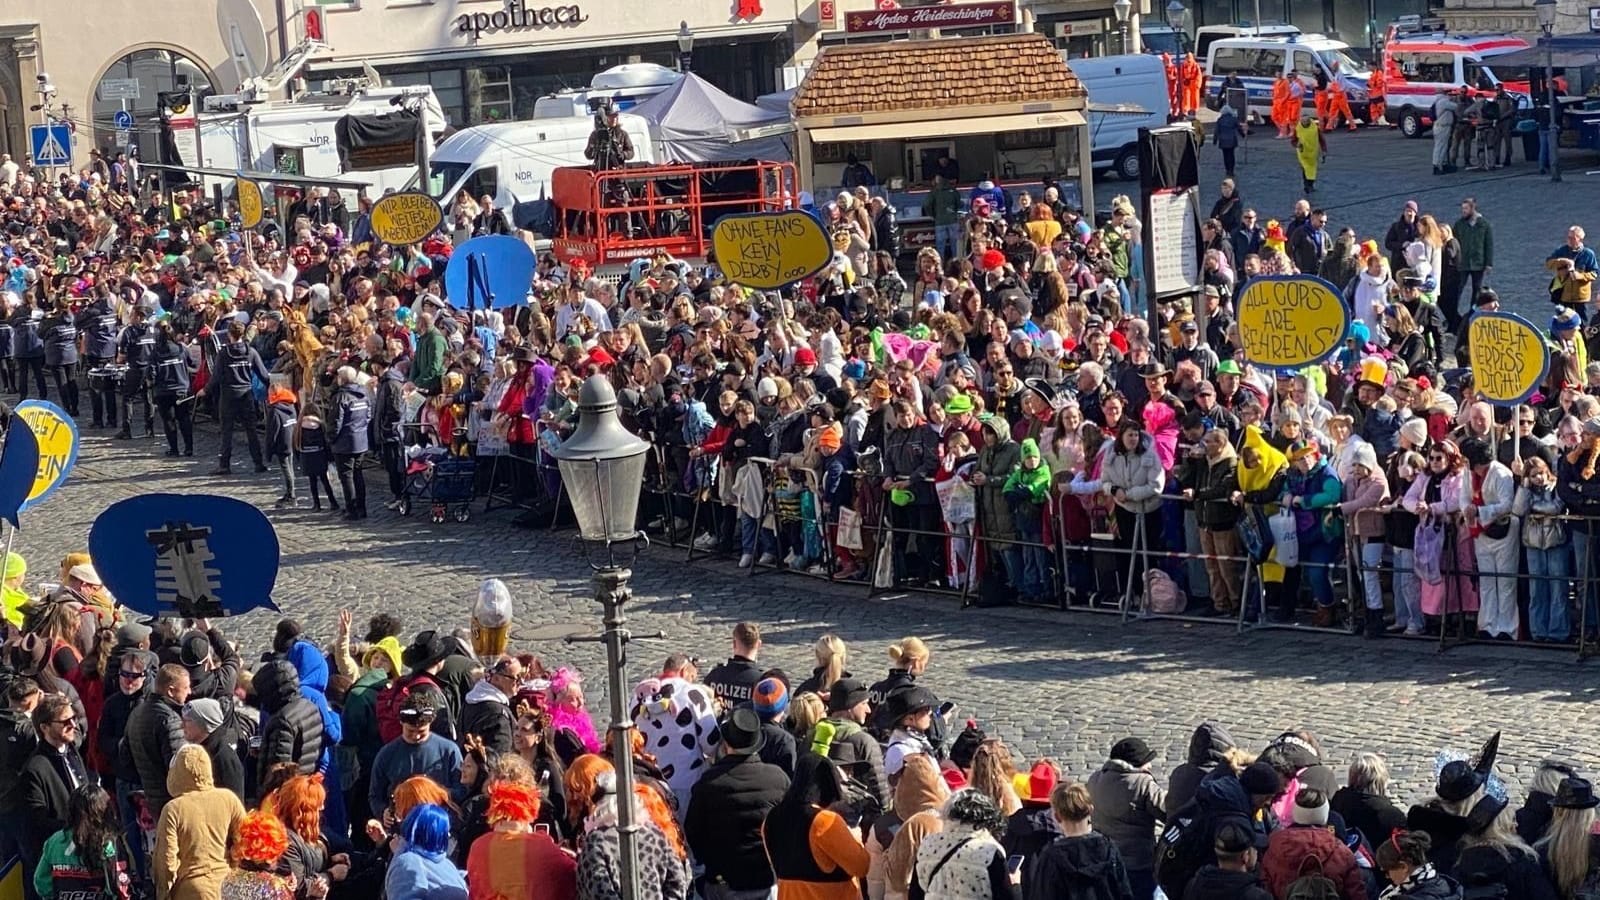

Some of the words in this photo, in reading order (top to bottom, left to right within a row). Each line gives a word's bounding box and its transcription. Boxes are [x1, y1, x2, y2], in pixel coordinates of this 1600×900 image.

[459, 0, 589, 40] apotheca
[912, 8, 994, 23] Heideschinken
[515, 168, 532, 182] NDR
[380, 198, 398, 215] WIR
[720, 220, 764, 242] OHNE
[765, 218, 805, 238] FANS
[740, 239, 781, 261] KEIN
[1246, 284, 1269, 311] ALL
[1273, 281, 1325, 310] COPS
[1264, 308, 1296, 332] ARE
[1242, 323, 1340, 360] BEHRENS!
[1474, 319, 1528, 351] DANIELA
[1475, 344, 1524, 374] VERPISS
[710, 682, 752, 699] POLIZEI
